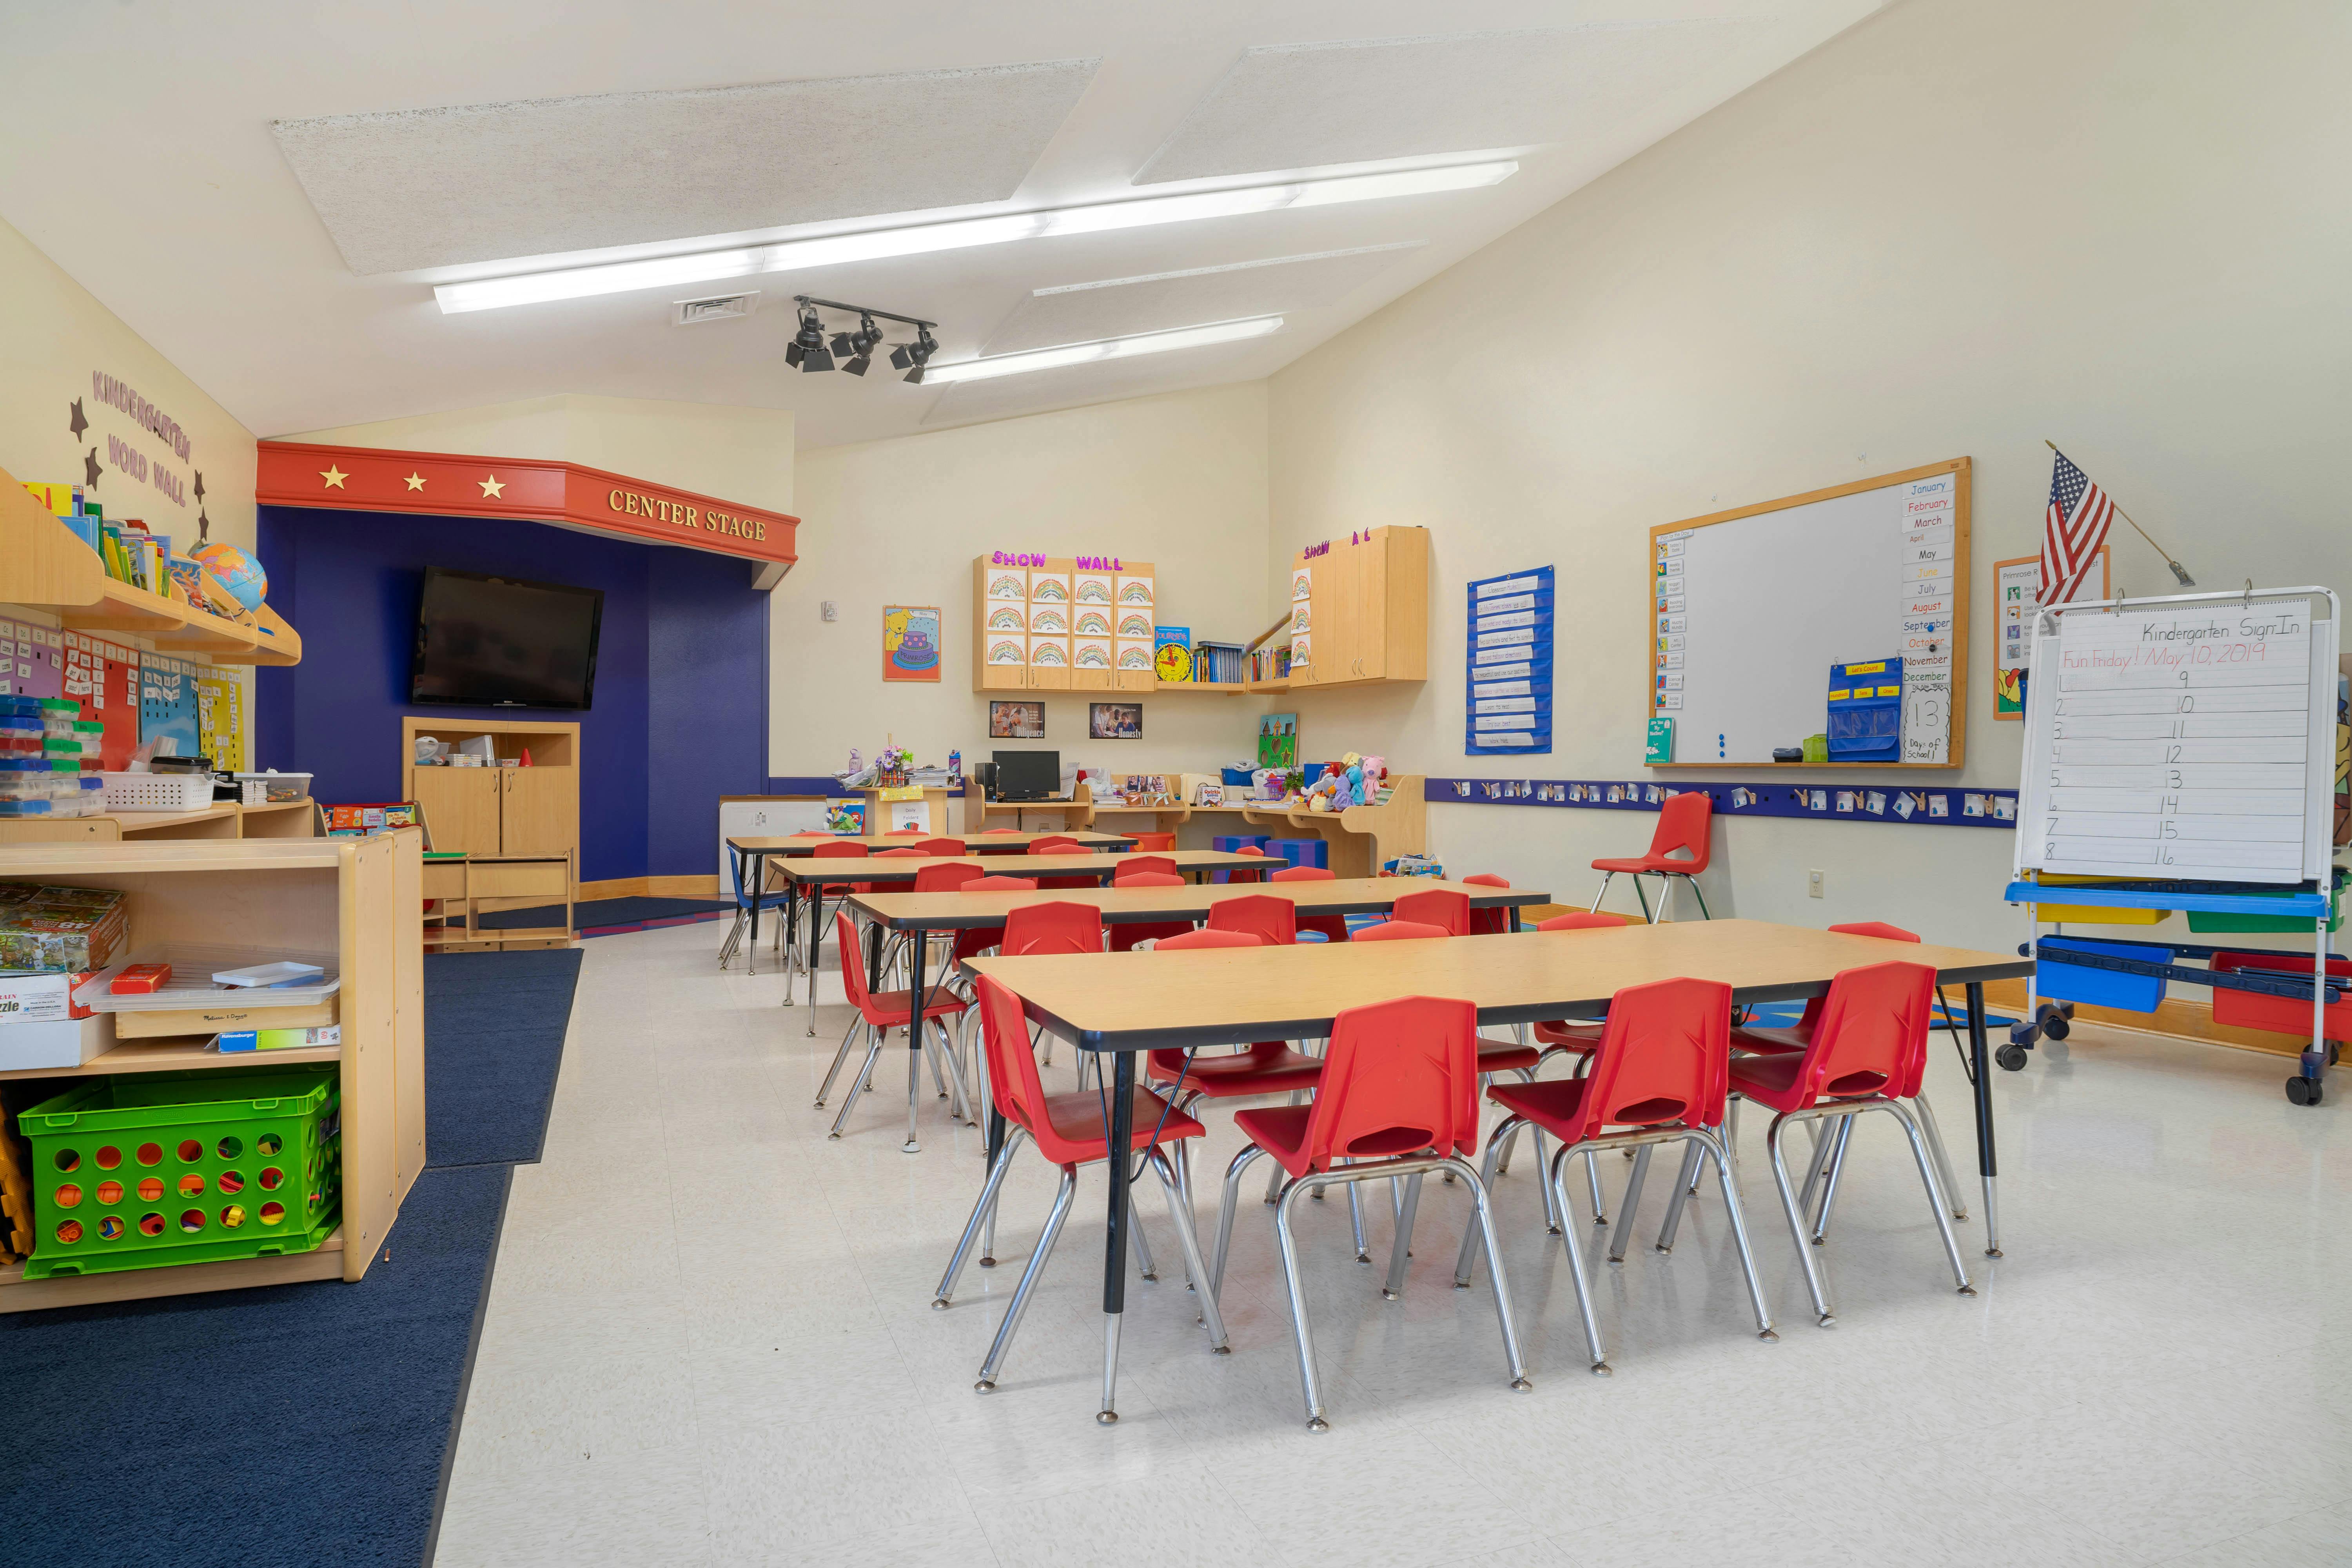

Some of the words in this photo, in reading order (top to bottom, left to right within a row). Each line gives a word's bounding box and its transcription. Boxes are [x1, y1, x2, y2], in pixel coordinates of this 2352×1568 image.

[93, 370, 191, 464] KINDERGARTEN
[108, 433, 147, 483] WORD
[154, 461, 186, 507] WALL
[1911, 482, 1946, 495] January
[1909, 499, 1948, 512] February
[609, 489, 698, 528] CENTER
[706, 511, 766, 541] STAGE
[1915, 515, 1942, 528] March
[1910, 534, 1924, 543] April
[1304, 540, 1330, 560] SHOW
[1919, 550, 1936, 561] May
[992, 551, 1046, 567] SHOW
[1076, 556, 1123, 571] WALL
[1917, 568, 1938, 578] June
[2003, 570, 2031, 579] Primrose
[1918, 584, 1936, 595] July
[1912, 602, 1941, 614] August
[1904, 619, 1950, 632] September
[2143, 621, 2229, 645] Kindergarten
[1155, 631, 1187, 641] JOURNEYS
[1909, 637, 1945, 648] October
[900, 651, 933, 661] PRIMROSE
[1904, 655, 1947, 666] November
[2063, 650, 2087, 668] Fun
[2093, 645, 2139, 674] Friday!
[2145, 647, 2185, 672] May
[2191, 645, 2211, 666] 10,
[2217, 642, 2266, 663] 2019
[1904, 671, 1946, 682] December
[2180, 671, 2188, 688] 9
[2055, 699, 2065, 715] 2
[2178, 696, 2194, 713] 10
[1017, 727, 1044, 739] Diligence
[1119, 728, 1141, 740] Honesty
[2054, 722, 2062, 739] 3
[1929, 738, 1941, 750] of
[2053, 746, 2061, 763] 4
[2166, 746, 2181, 763] 12
[2051, 769, 2060, 787] 5
[2165, 770, 2182, 788] 13
[2049, 794, 2057, 811] 6
[2161, 796, 2178, 814] 14
[2047, 818, 2058, 835] 7
[2159, 821, 2178, 839] 15
[2046, 842, 2055, 860] 8
[2155, 846, 2173, 865] 16
